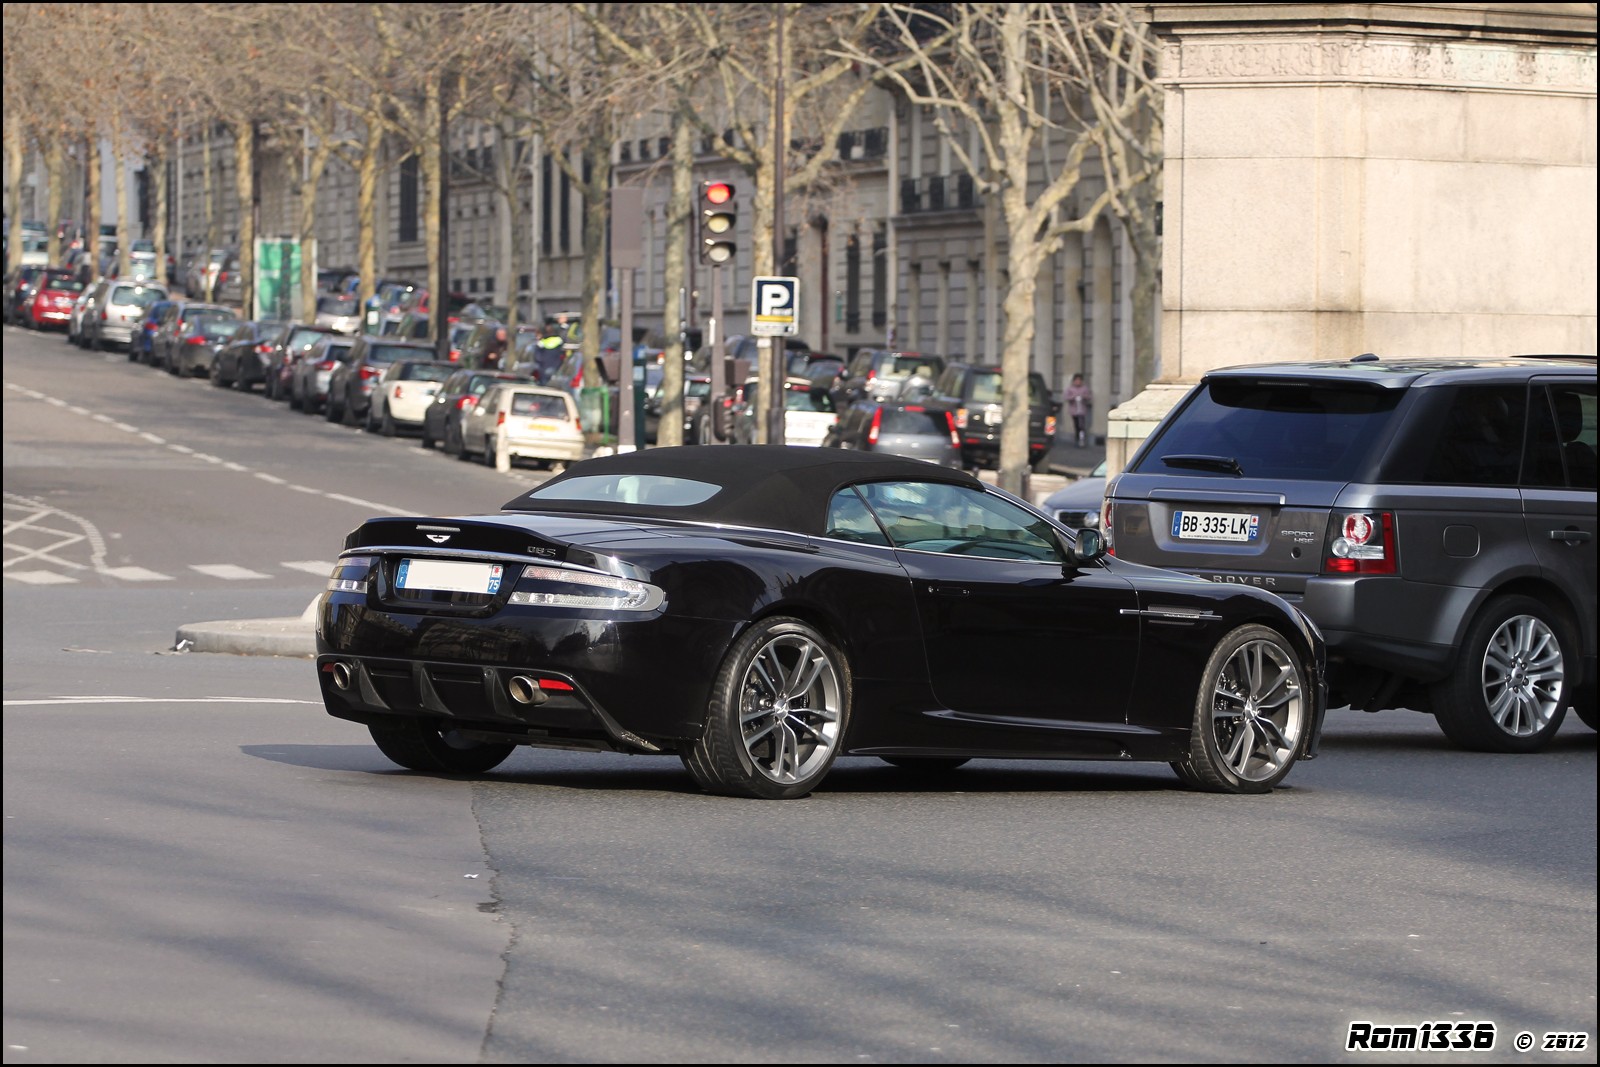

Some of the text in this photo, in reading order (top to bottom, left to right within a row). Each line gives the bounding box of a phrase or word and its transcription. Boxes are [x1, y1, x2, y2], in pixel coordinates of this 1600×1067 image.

[762, 284, 790, 316] P
[1249, 528, 1258, 537] 75
[489, 580, 499, 590] 75
[1213, 575, 1276, 586] ROVER
